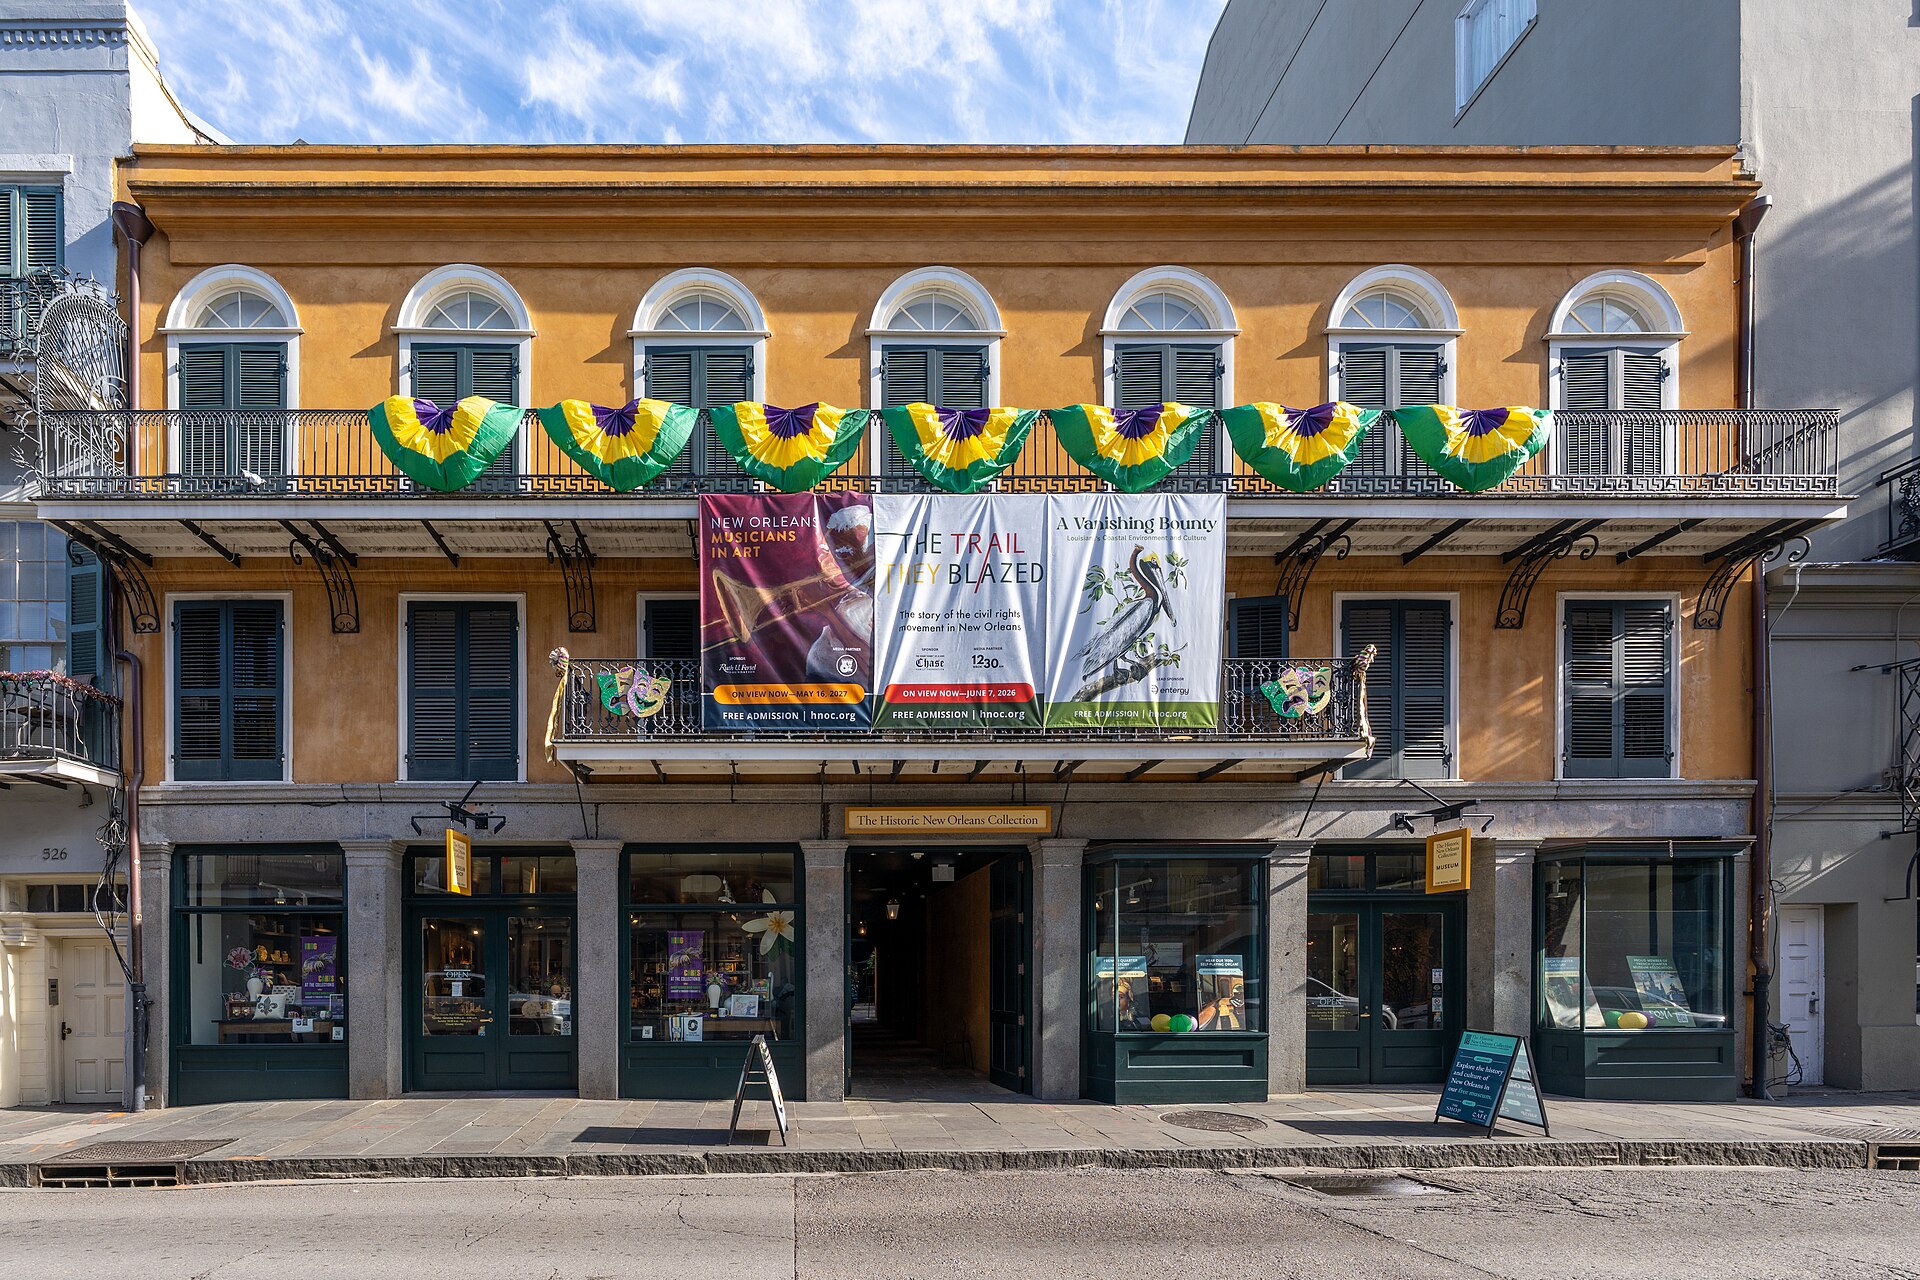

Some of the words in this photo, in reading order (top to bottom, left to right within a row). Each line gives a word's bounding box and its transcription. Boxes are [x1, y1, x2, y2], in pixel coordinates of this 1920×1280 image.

[711, 517, 744, 528] NEW
[750, 516, 818, 528] ORLEANS
[1056, 517, 1068, 530] A
[1074, 516, 1154, 534] Vanishing
[1159, 516, 1218, 532] Bounty
[711, 530, 796, 544] MUSICIANS
[874, 524, 942, 554] THE
[712, 547, 727, 558] IN
[732, 546, 760, 558] ART
[883, 563, 941, 594] THEY
[949, 562, 1044, 584] BLAZED
[900, 610, 915, 619] The
[918, 612, 940, 621] story
[944, 610, 954, 619] of
[956, 610, 970, 618] the
[974, 609, 992, 618] civil
[995, 608, 1020, 620] rights
[899, 624, 944, 632] movement
[947, 623, 956, 632] in
[958, 623, 980, 632] New
[984, 622, 1022, 631] Orleans
[916, 658, 945, 668] Chase
[988, 690, 995, 698] 7,
[722, 712, 744, 720] FREE
[747, 712, 799, 720] ADMISSION
[810, 711, 856, 721] hnoc.org
[980, 710, 1025, 720] hnoc.org
[856, 815, 877, 826] The
[880, 815, 919, 825] Historic
[923, 815, 945, 825] New
[948, 814, 985, 825] Orleans
[988, 814, 1038, 825] Collection
[42, 848, 68, 860] 526
[1456, 1061, 1475, 1070] Explore
[1485, 1066, 1504, 1076] history
[1464, 1080, 1483, 1089] Orleans
